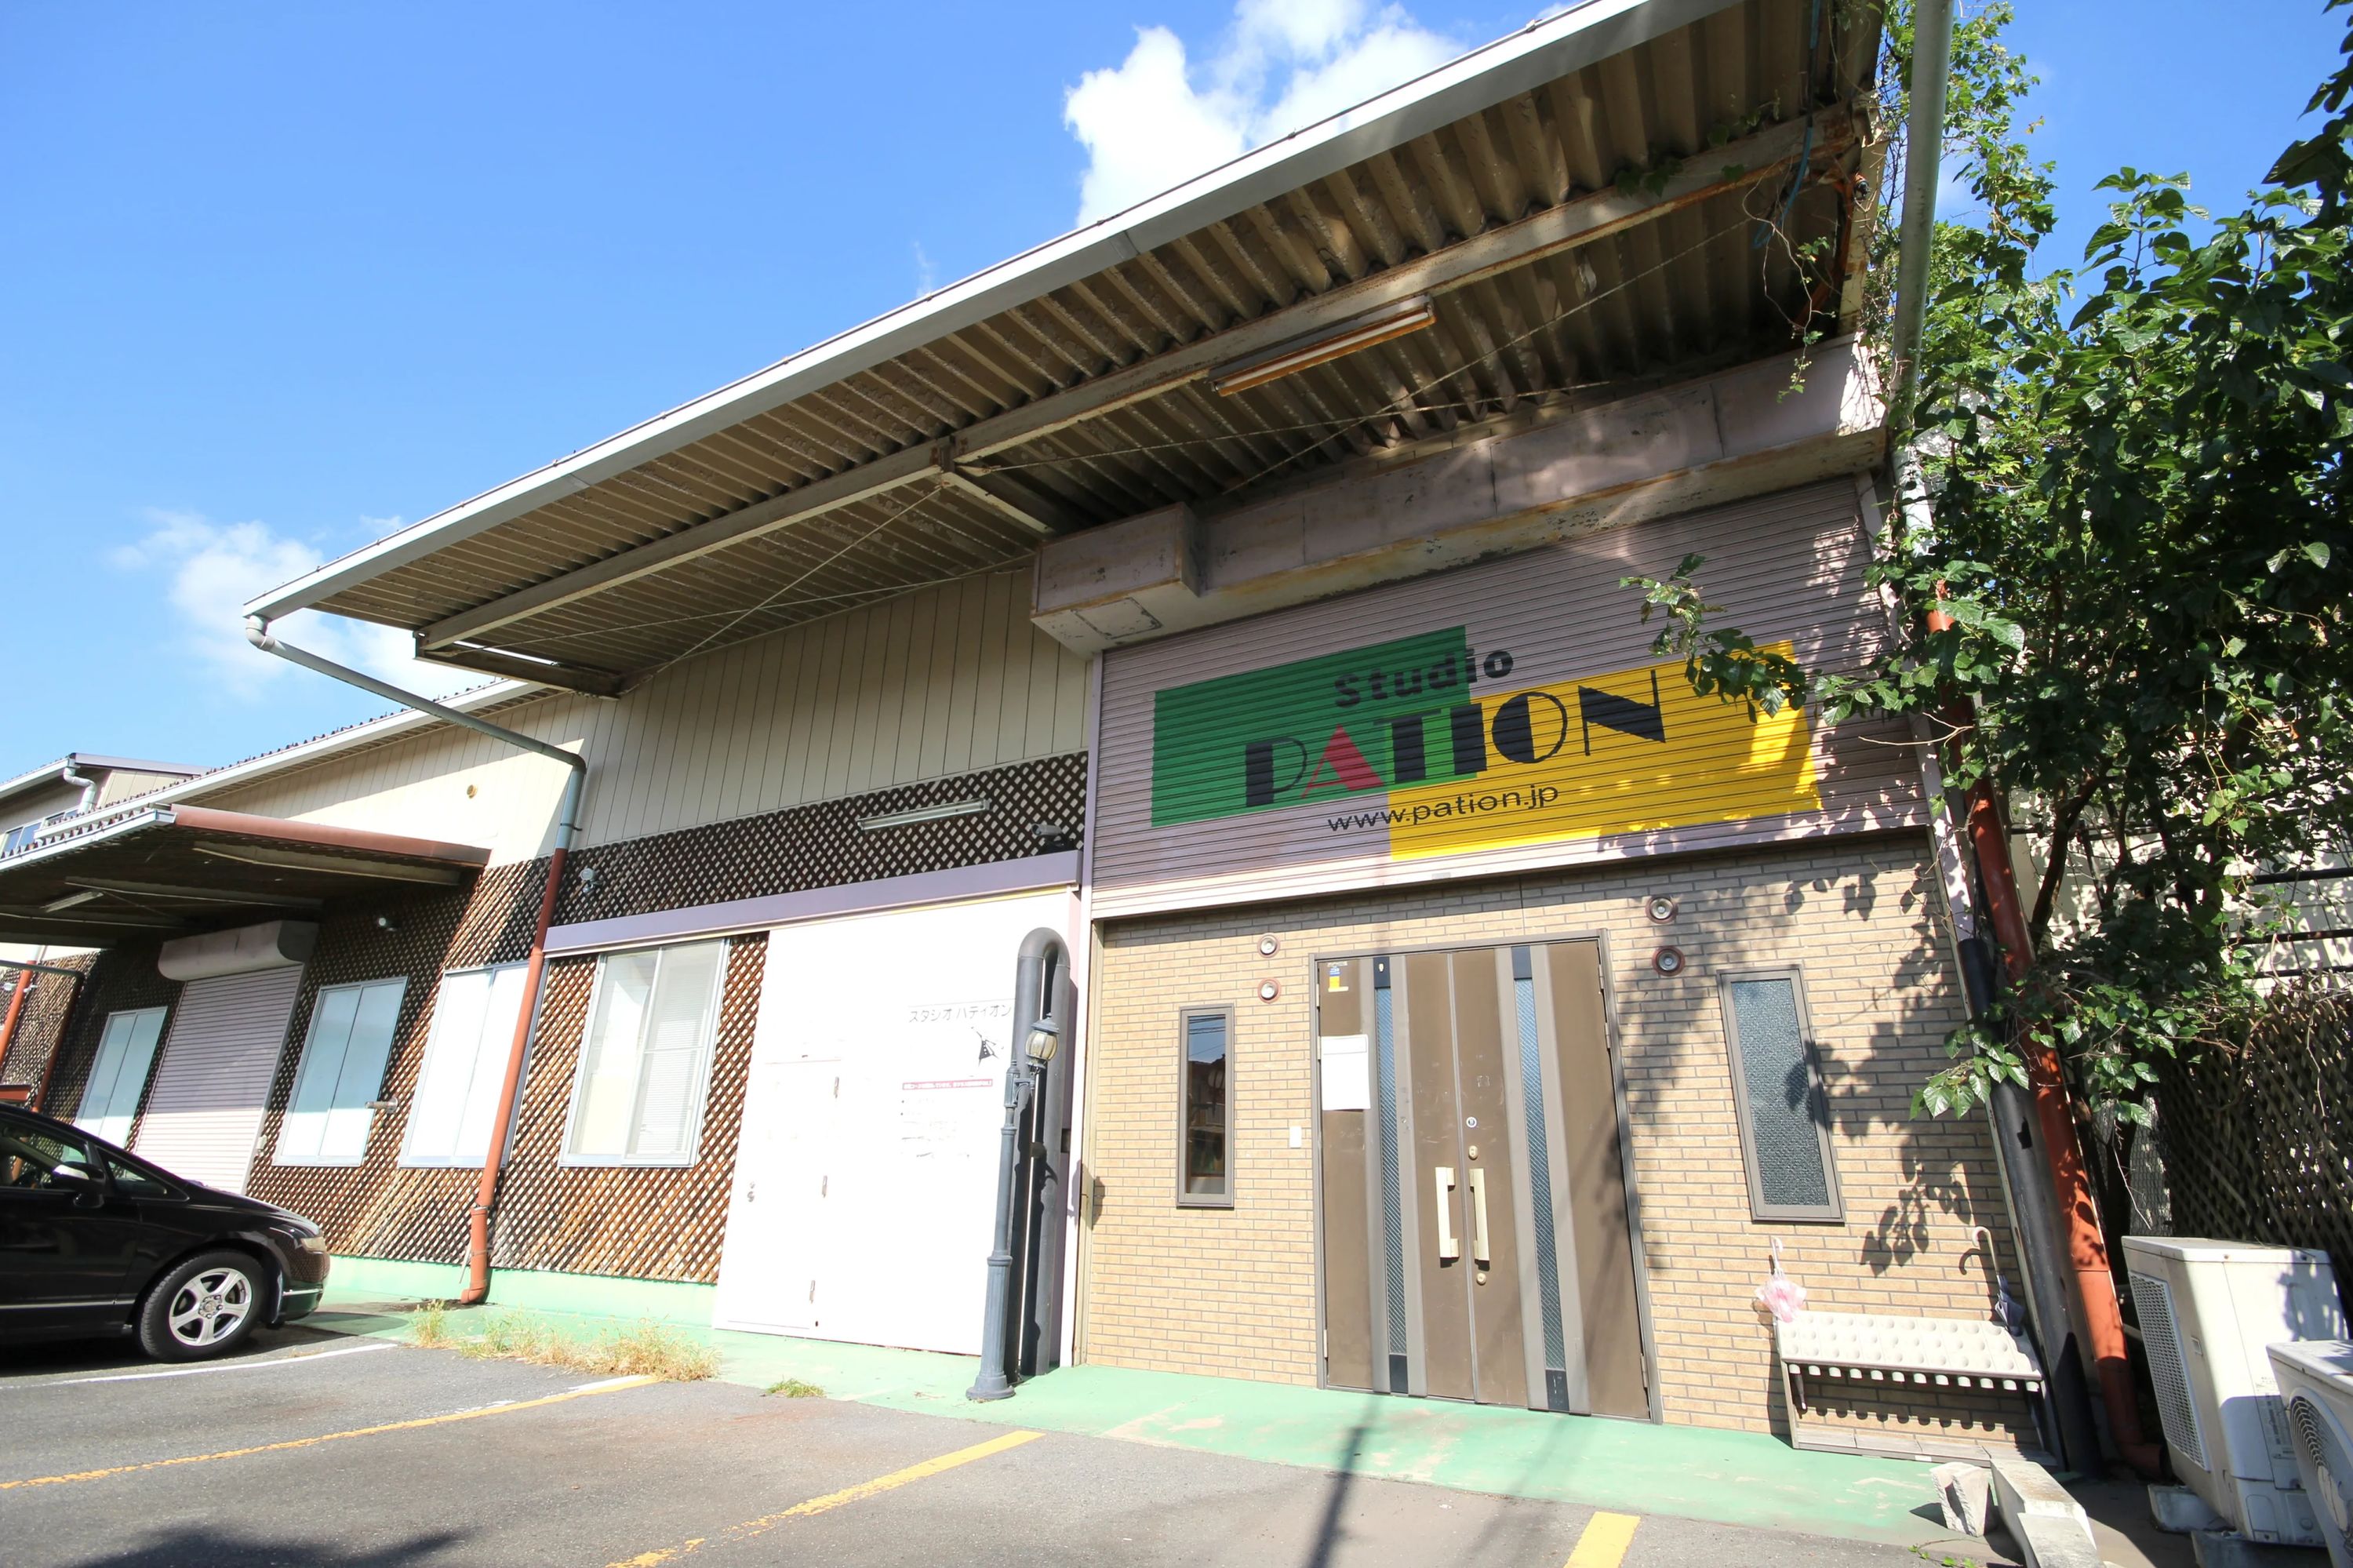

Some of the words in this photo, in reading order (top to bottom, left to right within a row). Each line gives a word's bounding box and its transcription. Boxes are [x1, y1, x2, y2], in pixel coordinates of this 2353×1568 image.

[1335, 649, 1514, 708] Studio
[1246, 669, 1666, 807] PATION
[1328, 785, 1559, 832] www.pation.jp
